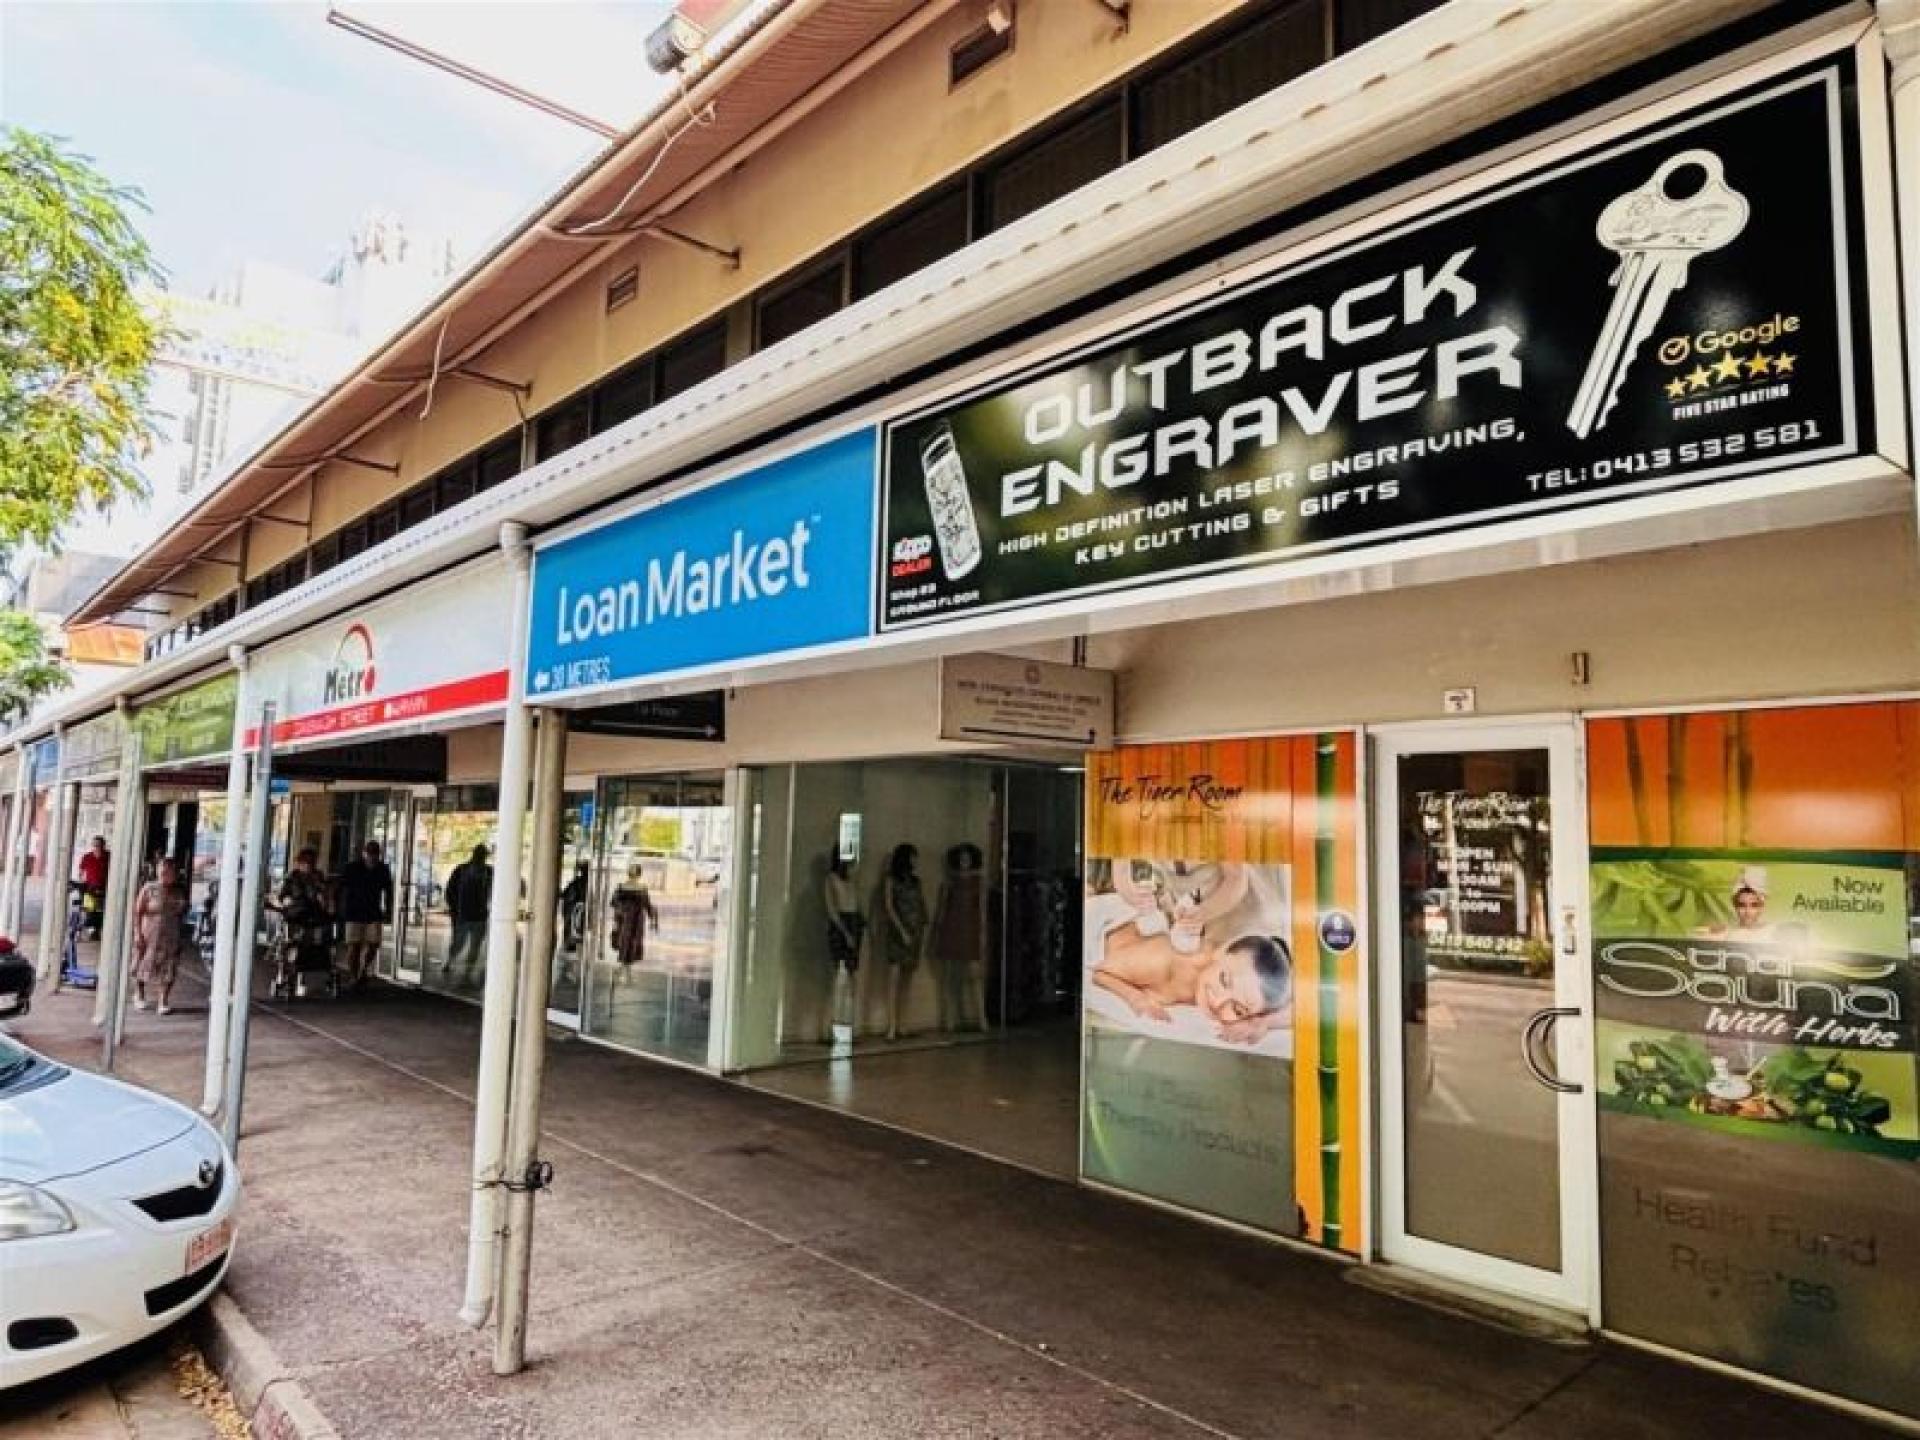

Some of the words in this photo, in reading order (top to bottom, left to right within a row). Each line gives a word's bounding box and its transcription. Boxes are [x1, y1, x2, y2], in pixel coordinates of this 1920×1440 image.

[1023, 246, 1477, 446] OUTBACK
[1694, 312, 1800, 353] Google
[1000, 324, 1522, 518] ENGRAVER
[1526, 467, 1587, 492] TEL:
[1592, 448, 1672, 480] 0413
[1679, 433, 1746, 463] 532
[1753, 419, 1823, 449] 581
[998, 531, 1048, 555] HIGH
[1055, 497, 1188, 543] DEFINITION
[1199, 471, 1296, 508] LASER
[1308, 417, 1525, 482] ENGRAVING,
[1075, 540, 1125, 565] KEY
[1134, 512, 1250, 553] CUTTING
[1262, 507, 1287, 525] &
[1300, 479, 1400, 517] GIFTS
[557, 579, 640, 646] Loan
[645, 519, 811, 626] Market
[568, 654, 611, 689] METRES
[1099, 776, 1132, 804] The
[1187, 774, 1243, 811] Room
[1793, 893, 1885, 914] Available
[1833, 875, 1884, 894] Now
[1600, 942, 1901, 1021] Sauna
[1704, 1006, 1791, 1036] With
[1791, 1016, 1901, 1048] Herbs
